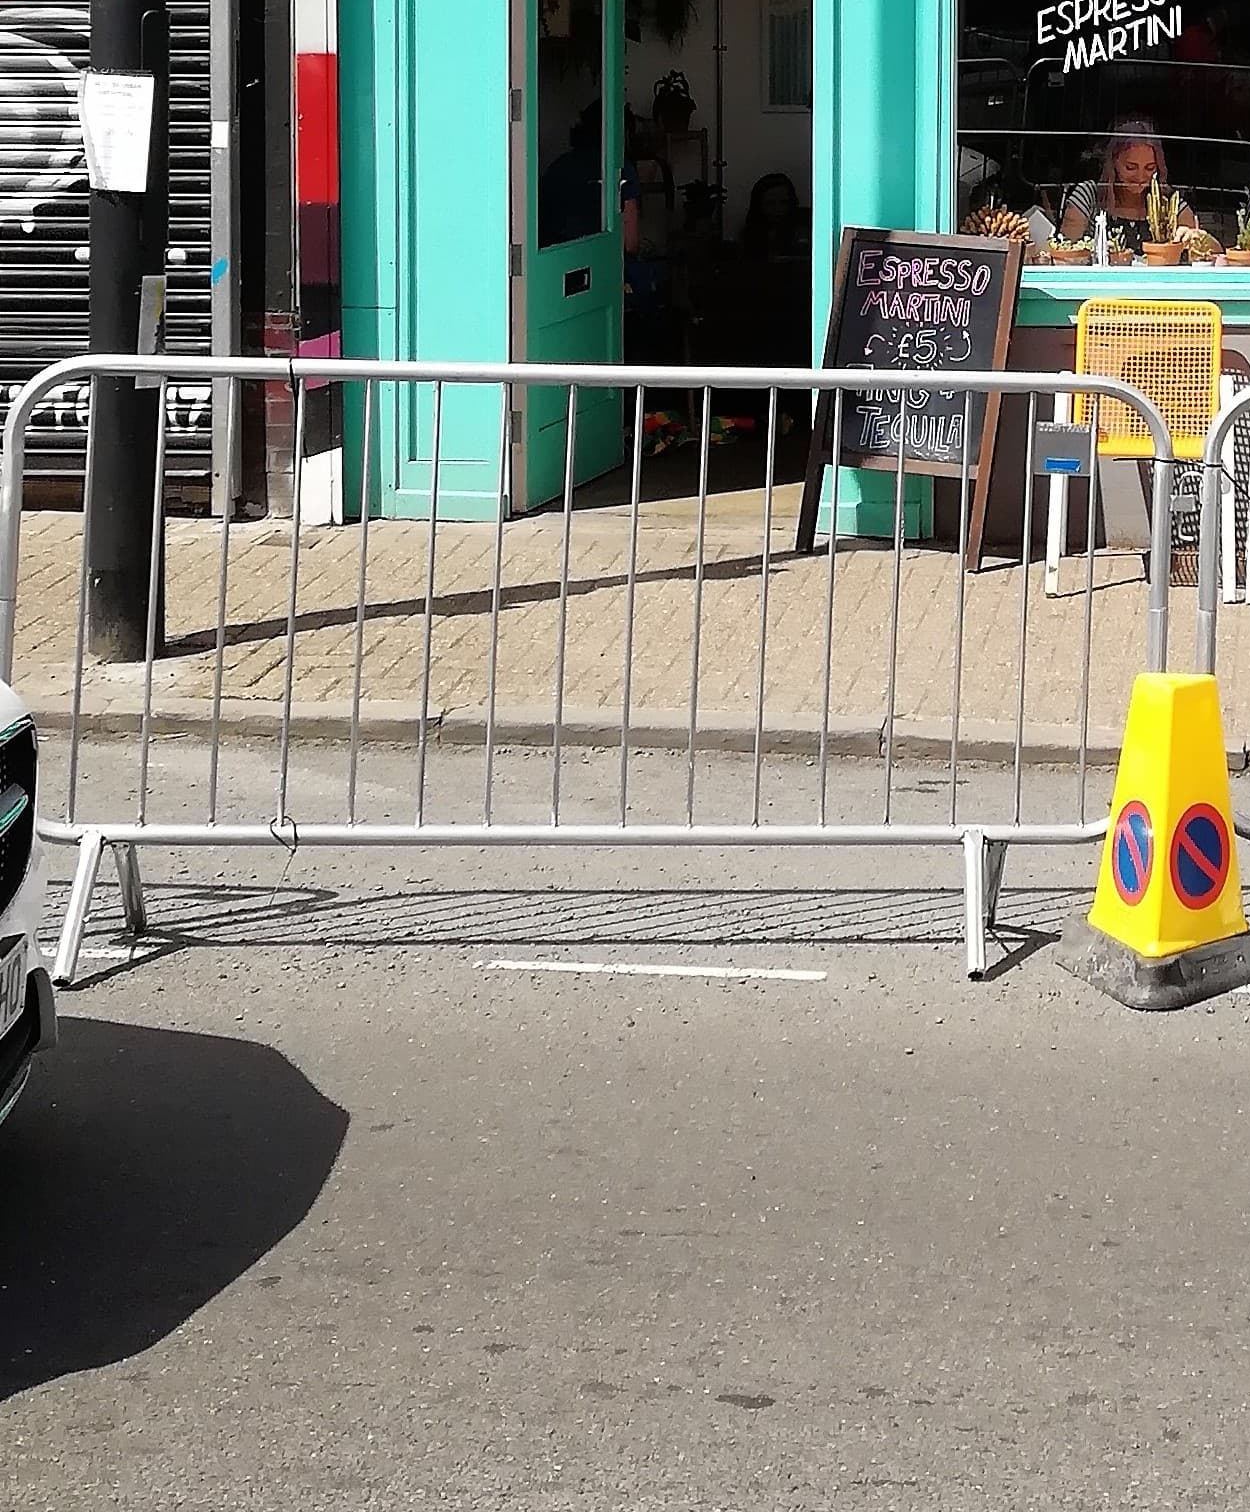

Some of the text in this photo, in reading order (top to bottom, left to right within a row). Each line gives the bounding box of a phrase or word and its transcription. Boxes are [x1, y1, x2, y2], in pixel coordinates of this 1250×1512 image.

[1062, 5, 1182, 73] MARTINI
[856, 250, 992, 296] ESPRESSO
[860, 290, 971, 327] MARTINI
[897, 329, 938, 365] £5
[856, 405, 964, 454] TEQUILA
